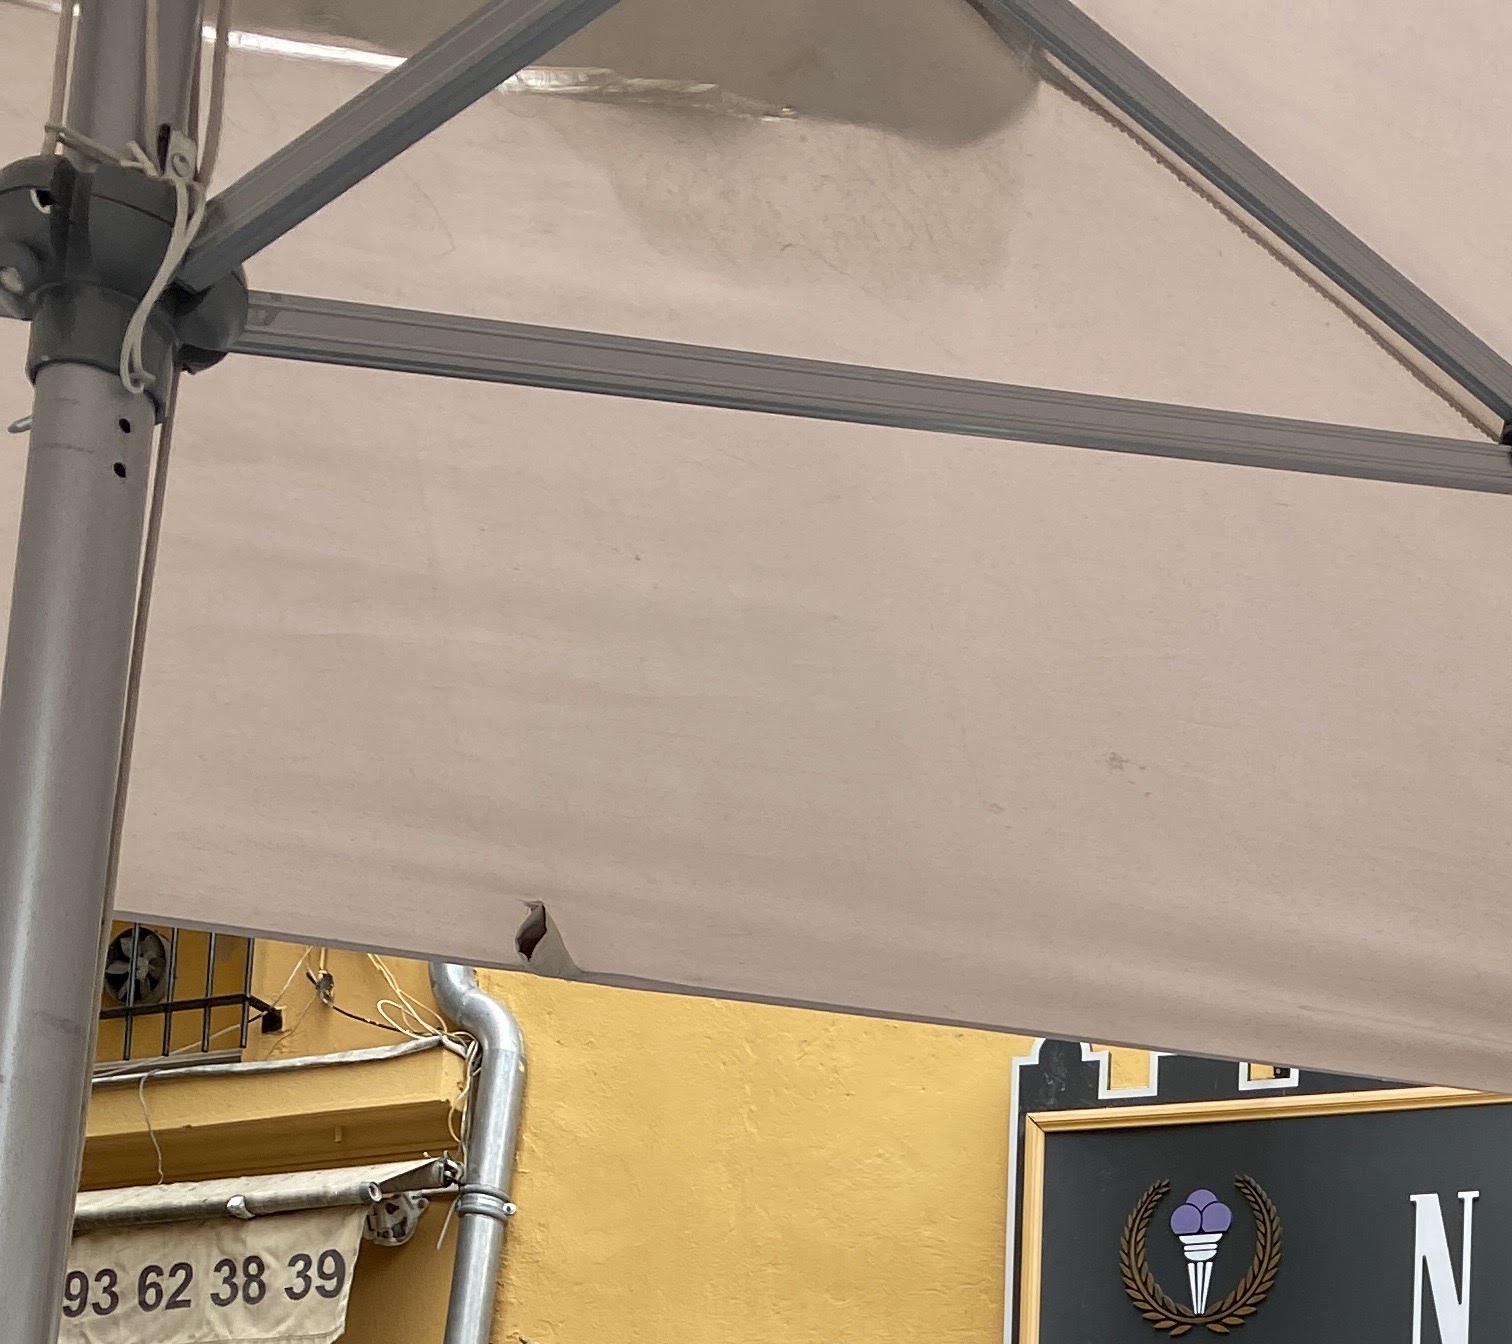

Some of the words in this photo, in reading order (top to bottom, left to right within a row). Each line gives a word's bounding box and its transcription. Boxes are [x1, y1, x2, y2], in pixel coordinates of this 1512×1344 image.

[63, 1270, 119, 1318] 93
[138, 1262, 193, 1312] 62
[210, 1255, 266, 1306] 38
[284, 1249, 346, 1300] 39
